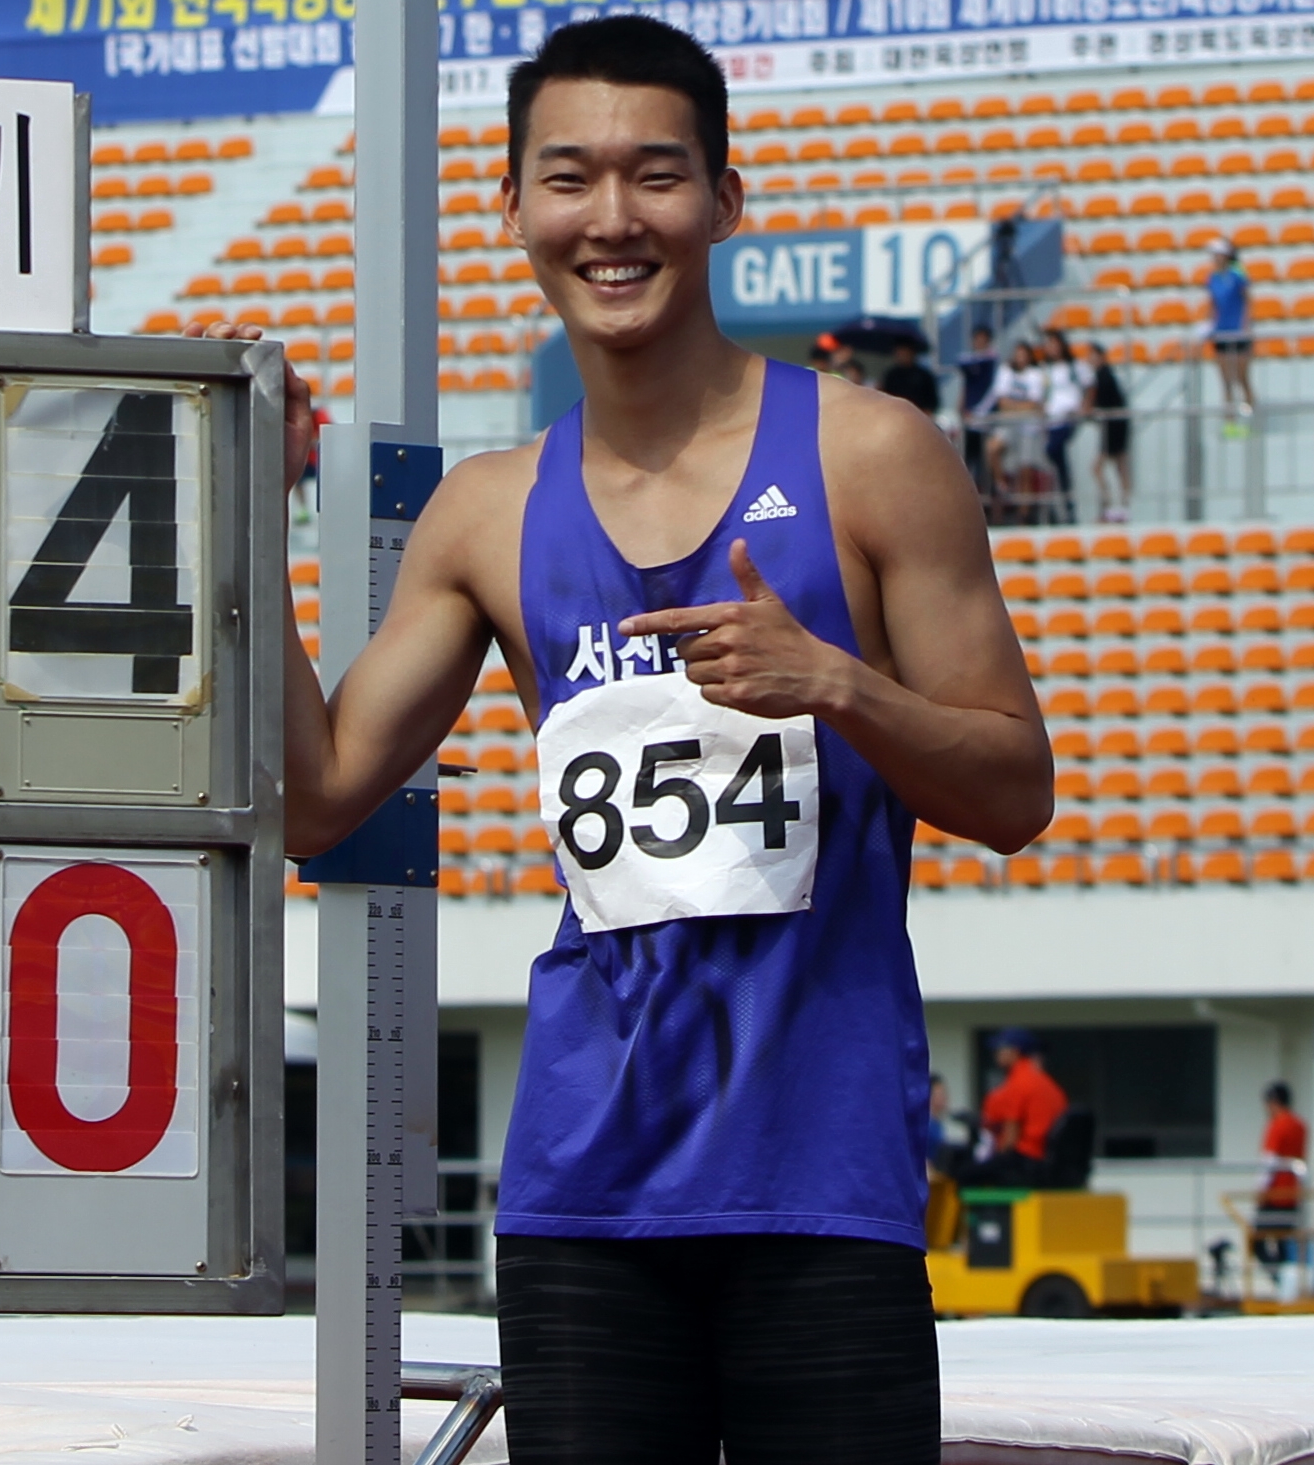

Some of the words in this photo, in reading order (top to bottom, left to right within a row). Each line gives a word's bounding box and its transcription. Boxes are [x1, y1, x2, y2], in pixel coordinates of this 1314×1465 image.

[732, 241, 851, 306] GATE
[879, 231, 961, 306] 10
[743, 504, 798, 523] adidas
[558, 732, 801, 871] 854
